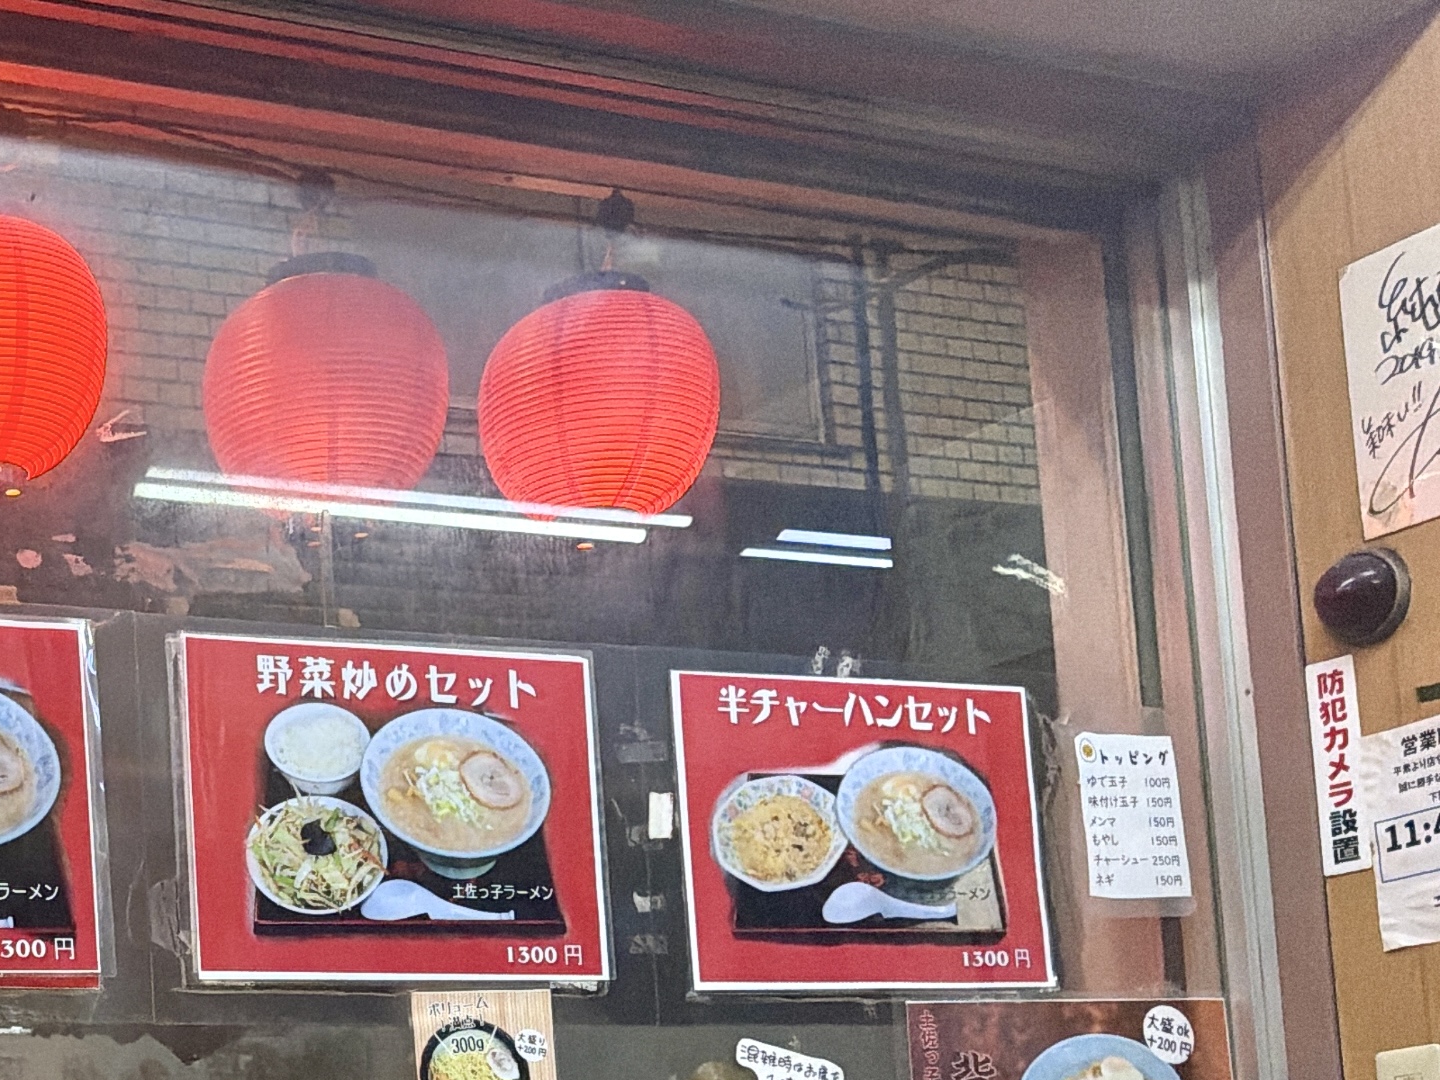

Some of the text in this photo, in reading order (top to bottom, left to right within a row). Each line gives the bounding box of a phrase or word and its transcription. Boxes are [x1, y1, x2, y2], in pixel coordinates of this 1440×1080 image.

[256, 654, 537, 709] 野菜炒めセット
[717, 684, 991, 735] 半チャーハンセット
[1401, 728, 1440, 757] 営業
[1099, 750, 1169, 766] トッピング
[1317, 669, 1362, 865] 防犯カメラ設置
[1087, 775, 1171, 789] ゆで玉子 100円
[1088, 795, 1173, 809] 味付け玉子 150円
[1090, 816, 1175, 828] メンマ 150円
[1092, 834, 1178, 847] もやし 150円
[1094, 854, 1180, 867] チャーシュー 250円
[1095, 873, 1183, 887] ネギ 150円
[452, 883, 554, 900] 土佐っ子ラーメン
[452, 1036, 484, 1053] 300g
